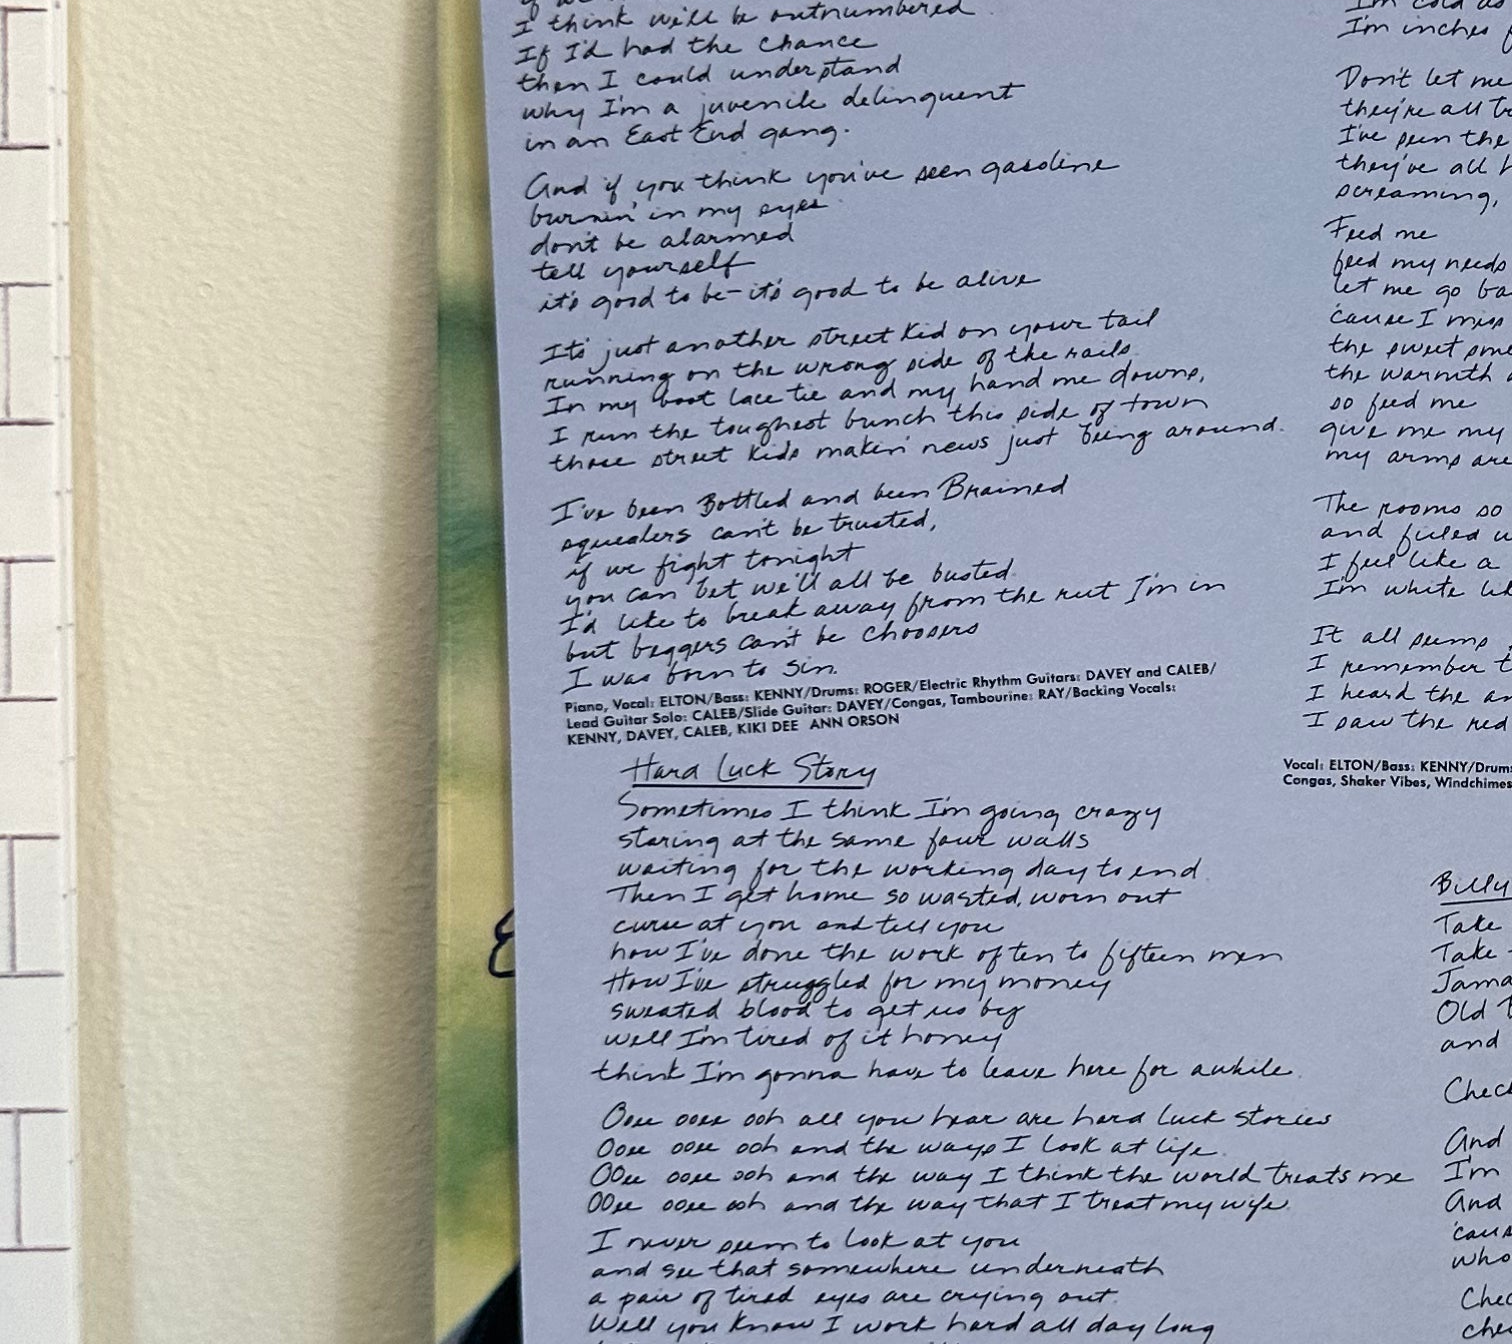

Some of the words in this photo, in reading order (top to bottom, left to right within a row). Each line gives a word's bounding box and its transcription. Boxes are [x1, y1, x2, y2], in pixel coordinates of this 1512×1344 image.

[621, 753, 699, 782] Hard
[717, 753, 781, 782] Luck
[794, 753, 877, 787] Story
[1431, 870, 1509, 898] Billy
